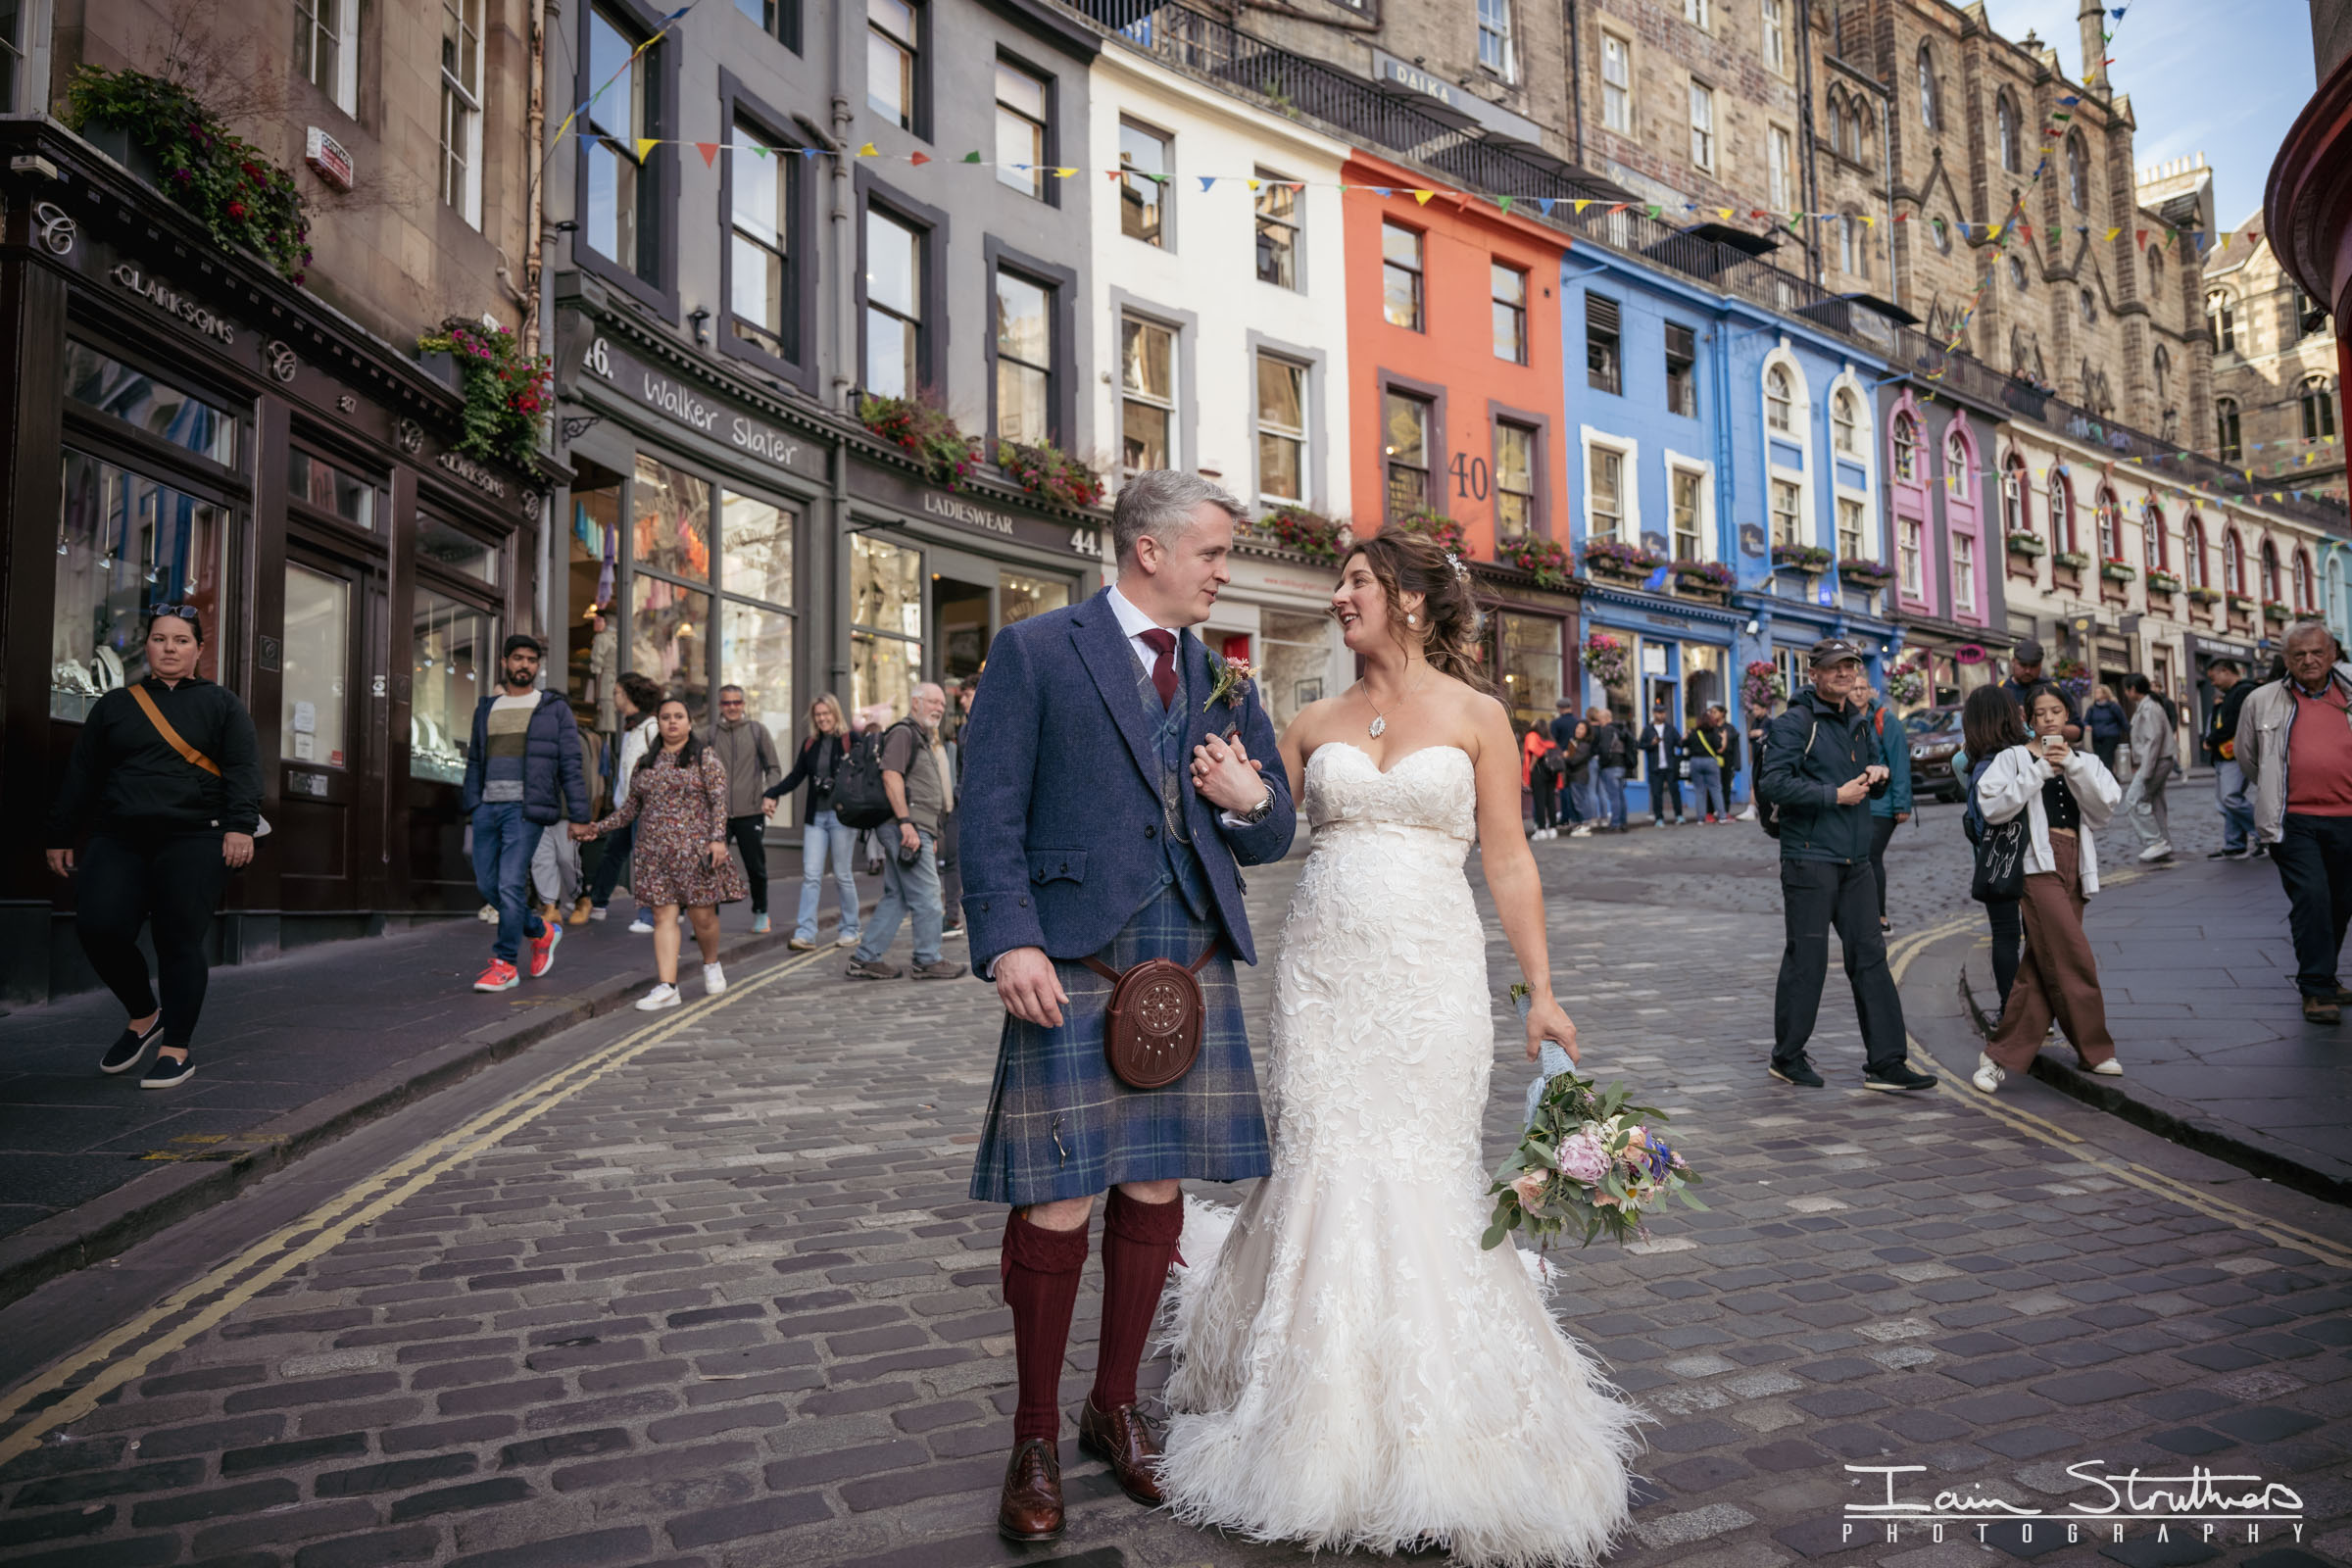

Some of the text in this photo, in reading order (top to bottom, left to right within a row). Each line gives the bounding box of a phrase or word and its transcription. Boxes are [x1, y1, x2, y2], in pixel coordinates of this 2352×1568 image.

[110, 264, 234, 344] CLARKSONS
[644, 372, 798, 465] Walker Slater
[1449, 452, 1489, 501] 40
[924, 493, 1013, 535] LADIESWEAR
